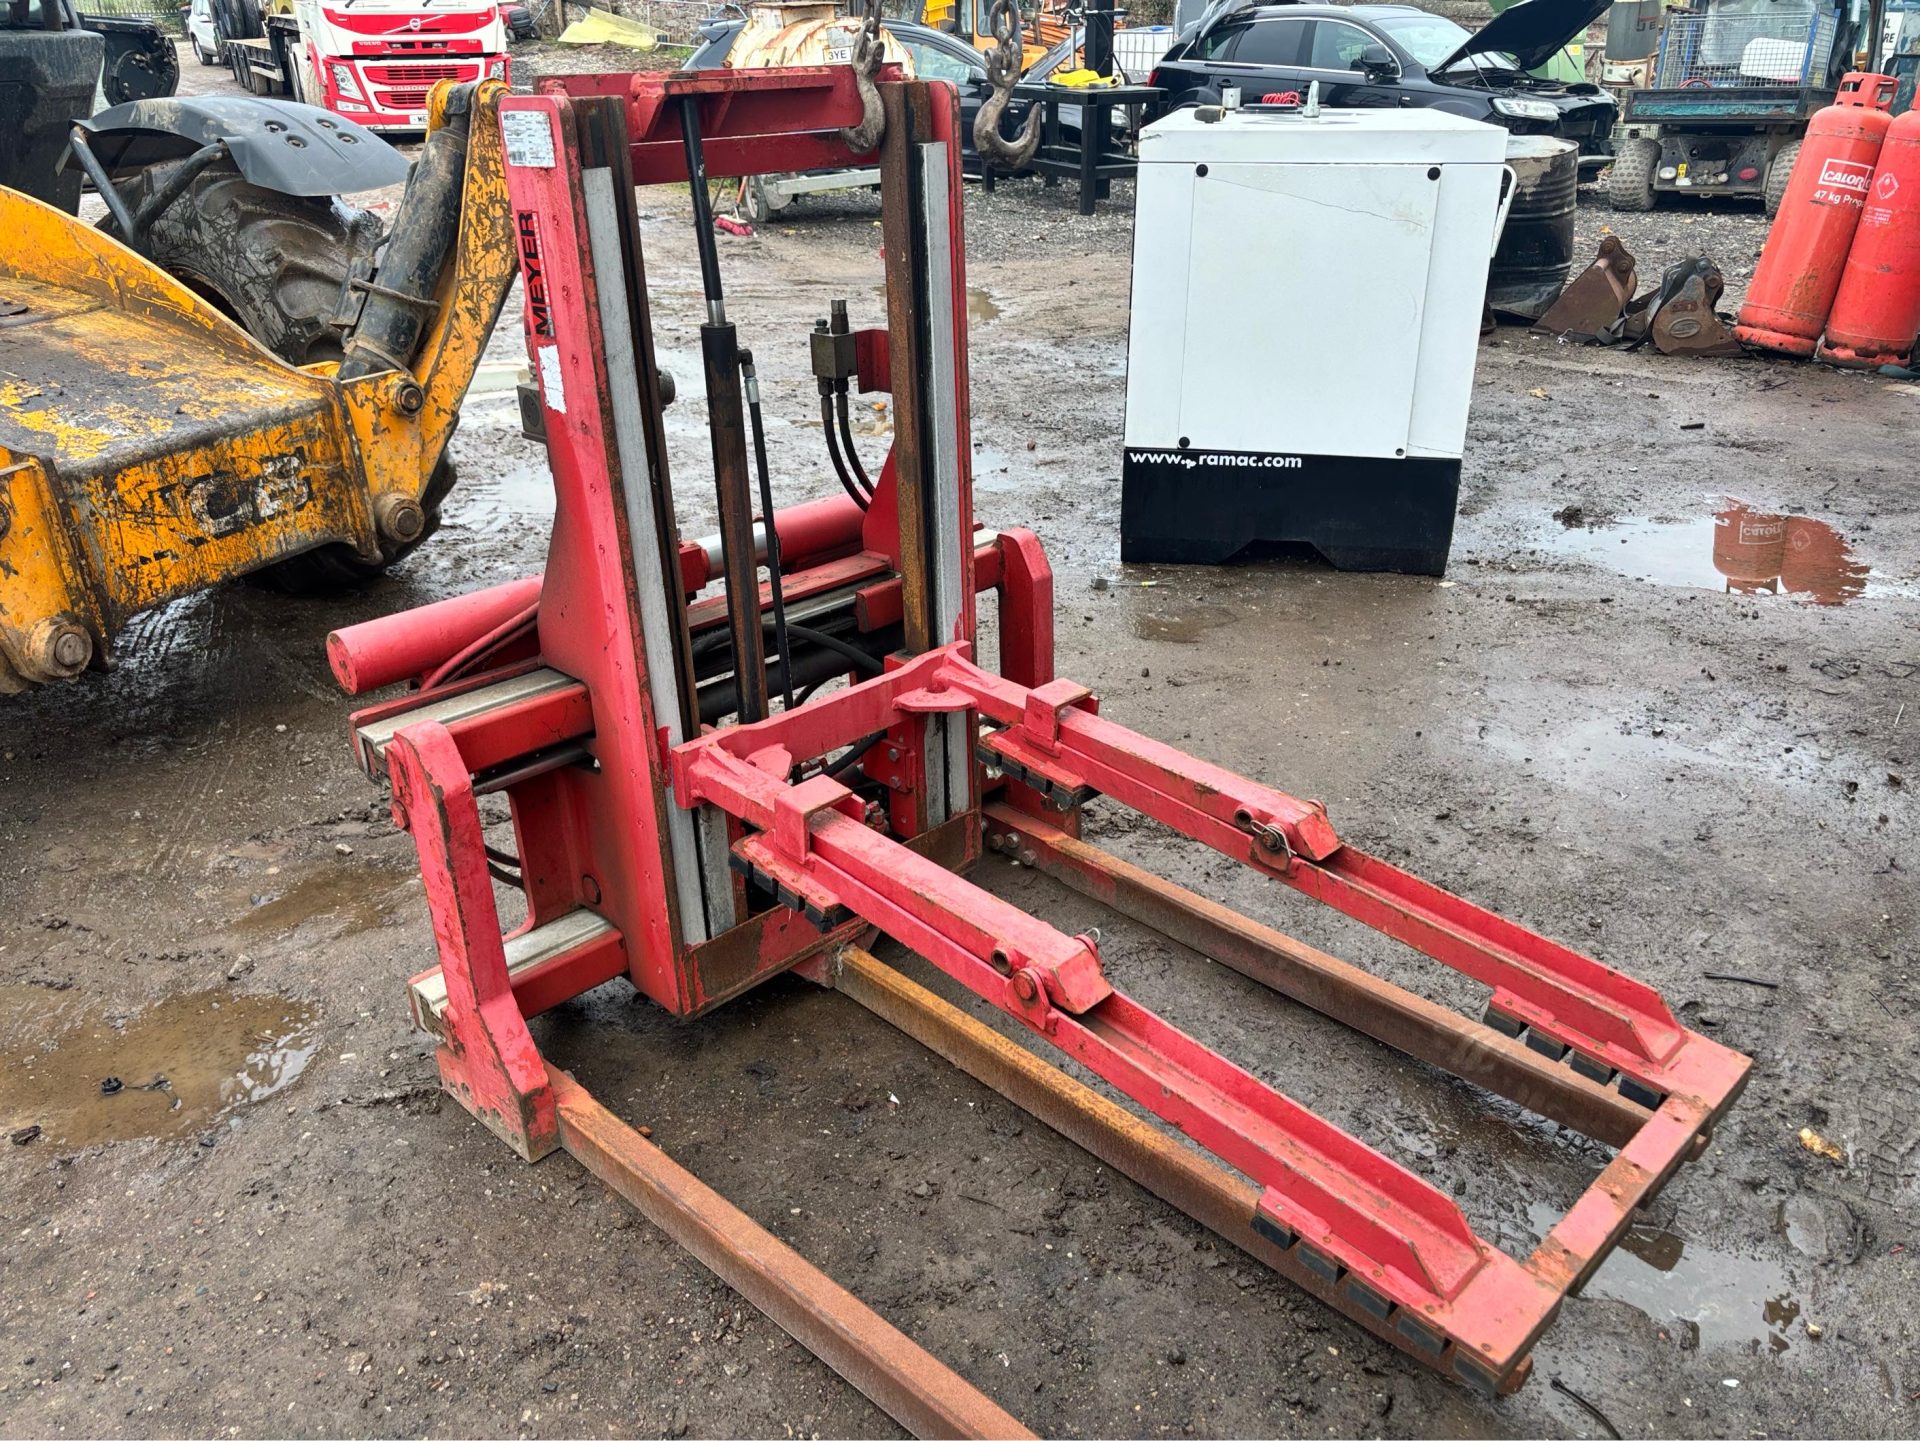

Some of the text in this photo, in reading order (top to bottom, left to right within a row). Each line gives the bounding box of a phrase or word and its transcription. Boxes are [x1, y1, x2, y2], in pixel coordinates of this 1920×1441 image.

[1824, 170, 1865, 191] CALOR
[1813, 189, 1827, 200] 47
[1827, 191, 1841, 205] kg
[519, 212, 548, 335] MEYER
